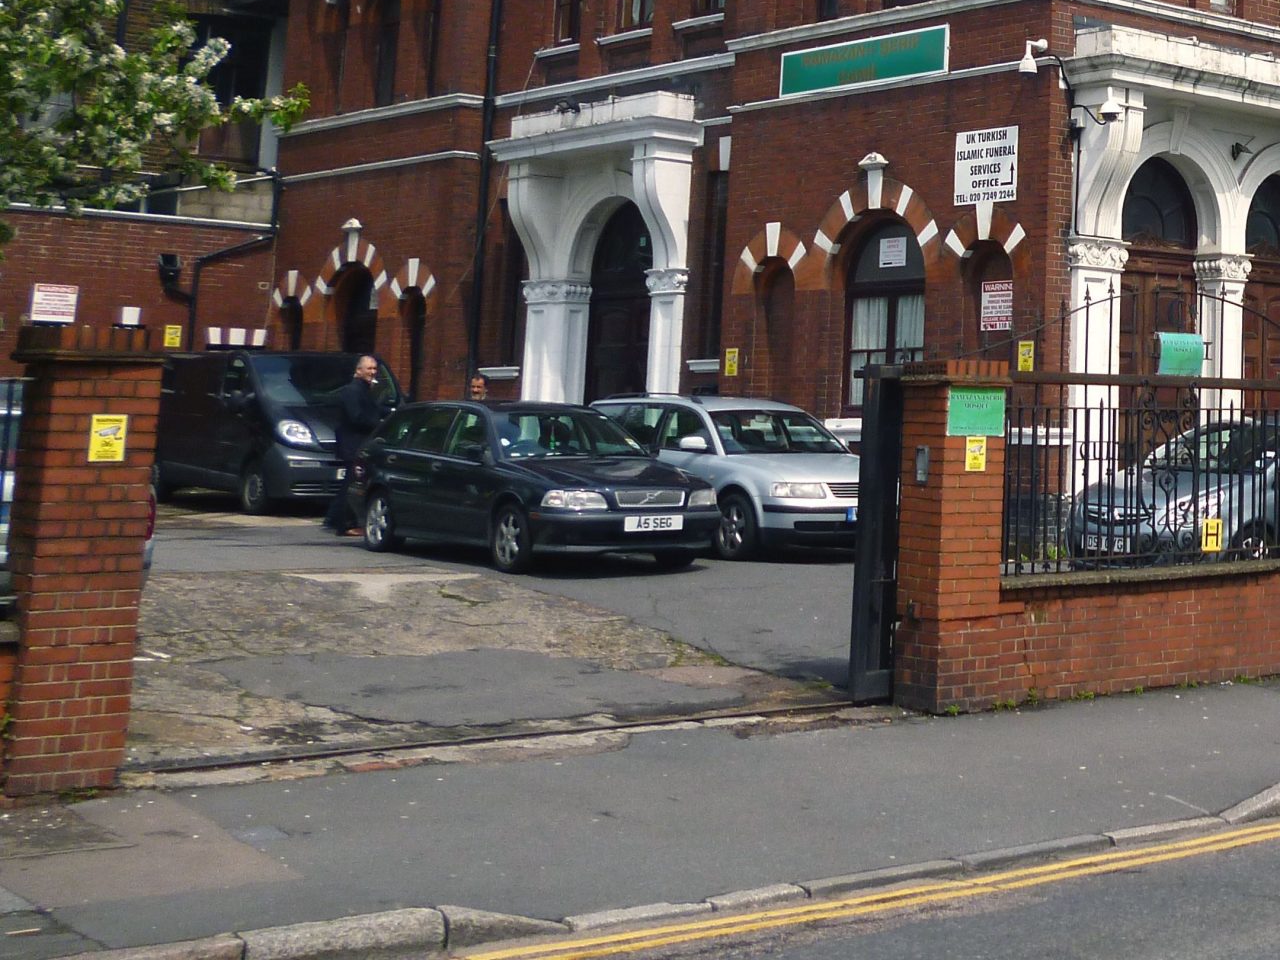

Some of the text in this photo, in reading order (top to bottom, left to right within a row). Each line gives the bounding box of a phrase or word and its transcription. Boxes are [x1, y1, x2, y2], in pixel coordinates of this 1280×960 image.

[966, 129, 1007, 144] UK TURKISH
[957, 145, 1015, 161] ISLAMIC FUNERAL
[970, 163, 1001, 176] SERVICES
[971, 178, 999, 189] OFFICE
[956, 194, 968, 203] TEL:
[969, 192, 980, 202] 020
[984, 283, 1012, 292] WARNIN
[637, 517, 672, 529] A5 SEG
[1205, 523, 1219, 547] H
